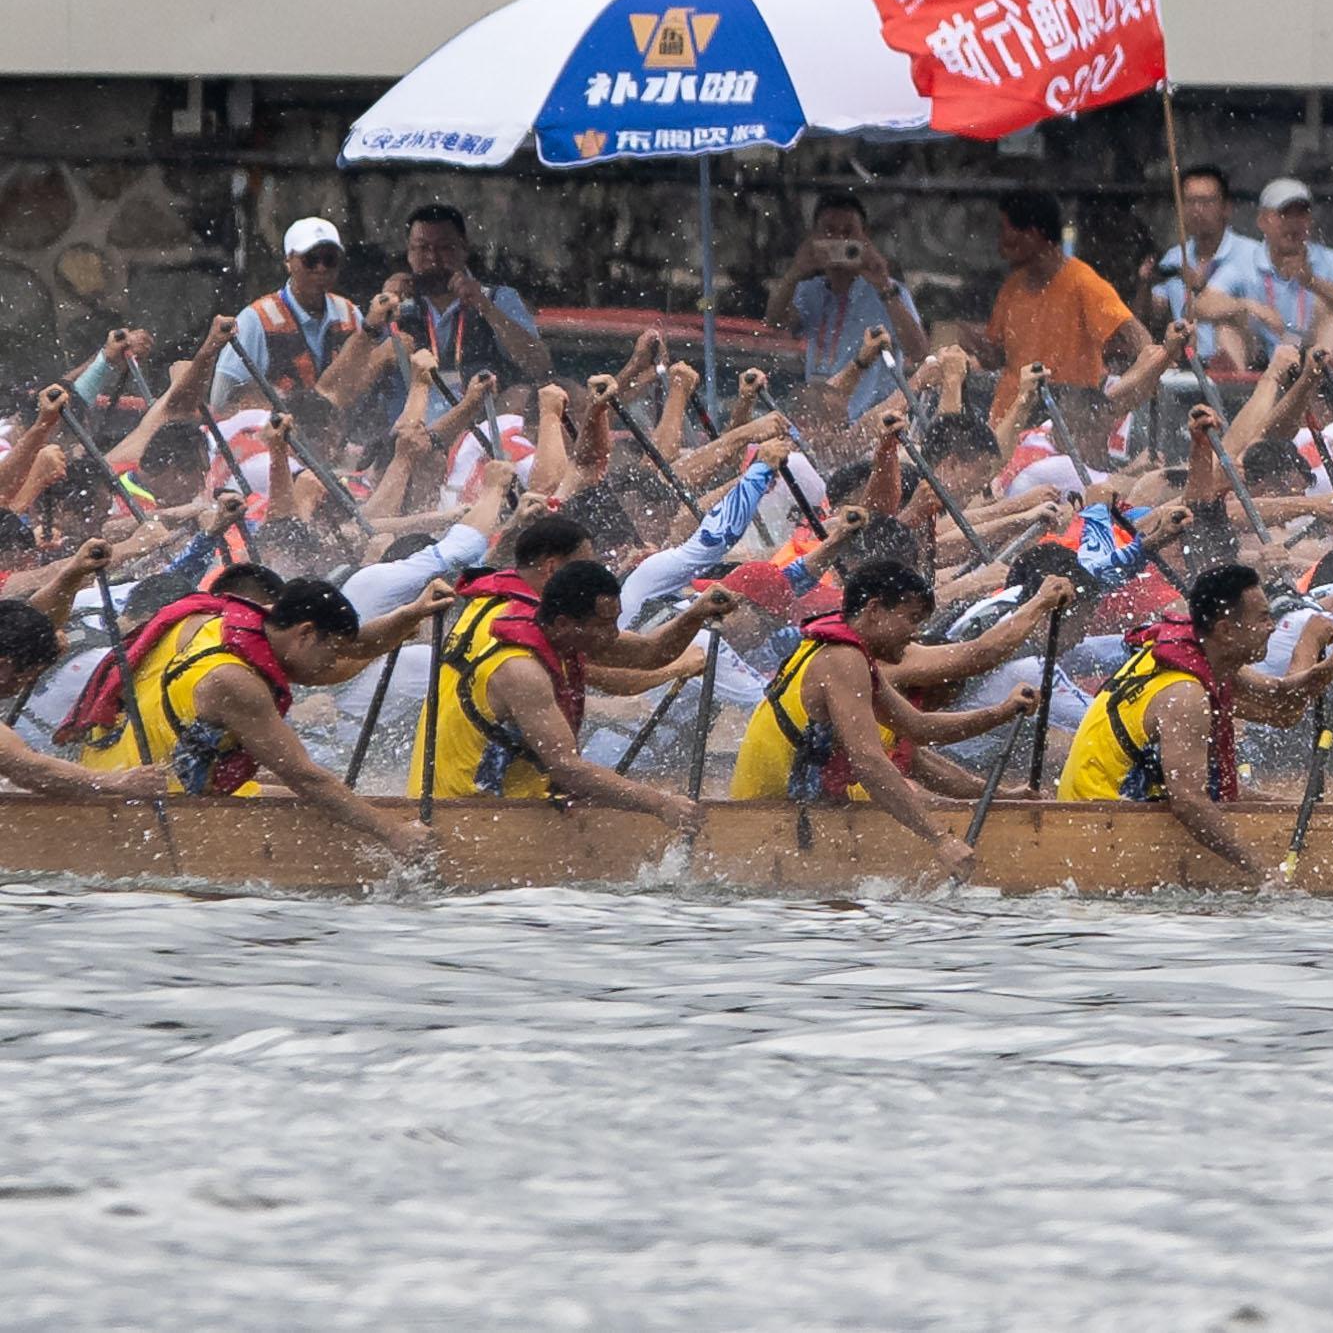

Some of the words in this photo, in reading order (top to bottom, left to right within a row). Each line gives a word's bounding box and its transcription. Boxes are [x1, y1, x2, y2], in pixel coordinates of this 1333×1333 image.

[584, 70, 760, 107] 补水啦
[615, 123, 768, 152] 东鹏饮料
